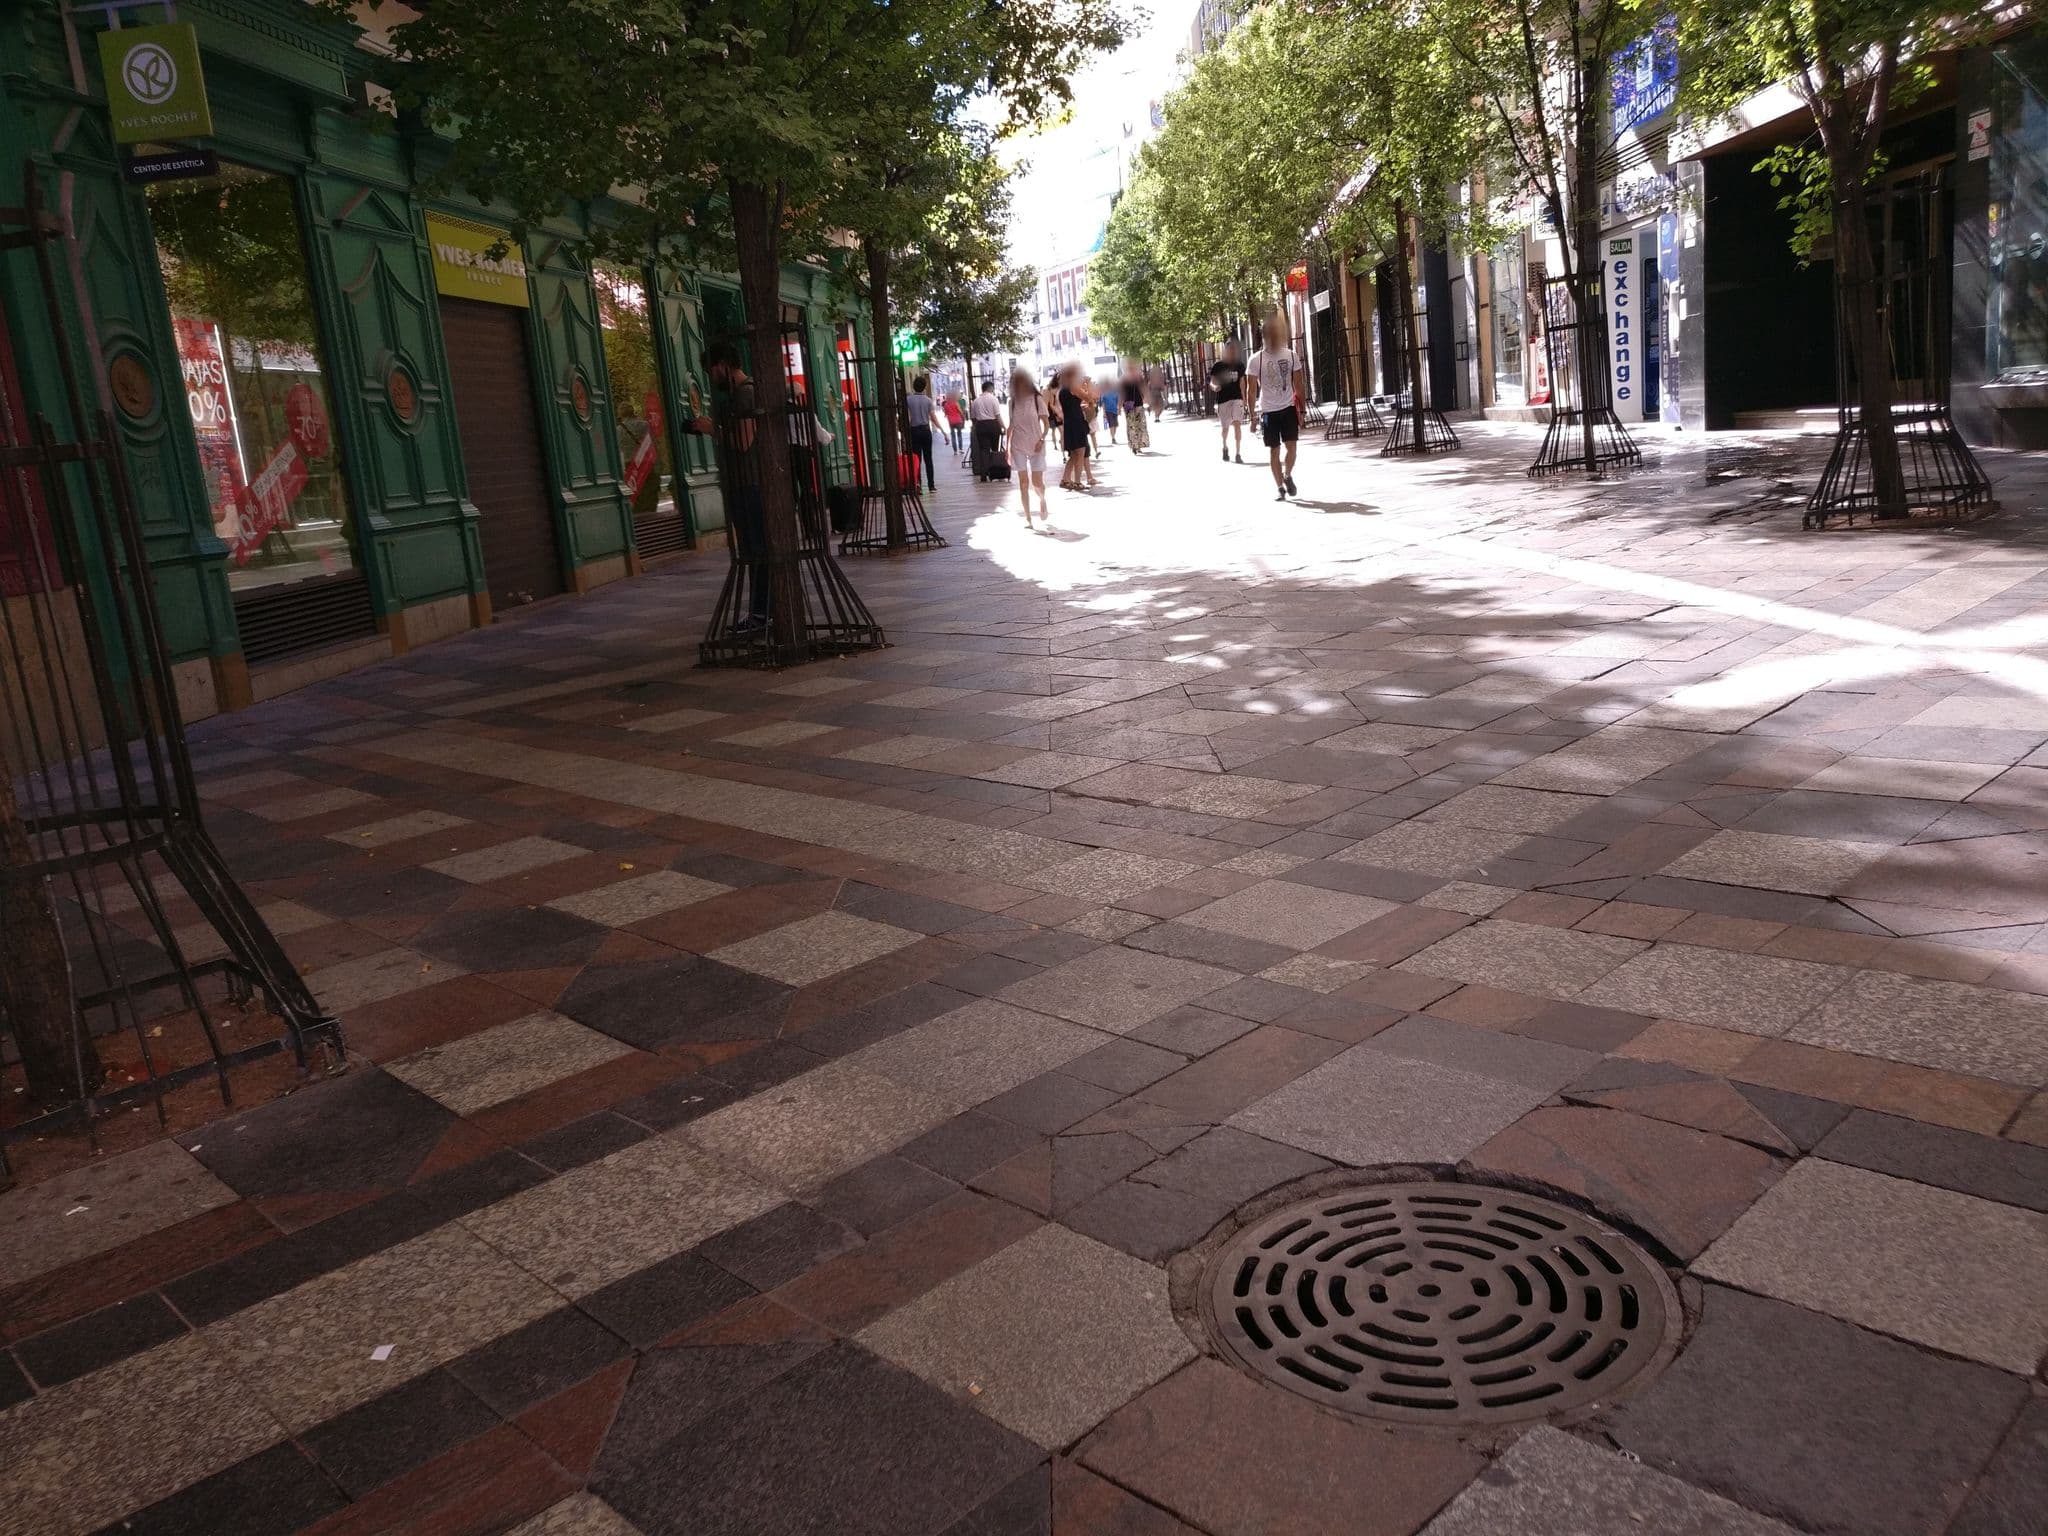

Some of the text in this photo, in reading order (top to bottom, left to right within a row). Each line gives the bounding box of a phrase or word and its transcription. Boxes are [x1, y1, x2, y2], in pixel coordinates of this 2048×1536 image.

[119, 111, 198, 128] YVES ROCHER
[133, 164, 162, 174] CENTRO
[173, 159, 205, 170] ESTÉTICA
[435, 242, 473, 267] YVES
[1610, 240, 1632, 254] SALIDA
[1661, 278, 1669, 313] 24
[1613, 259, 1631, 401] exchange
